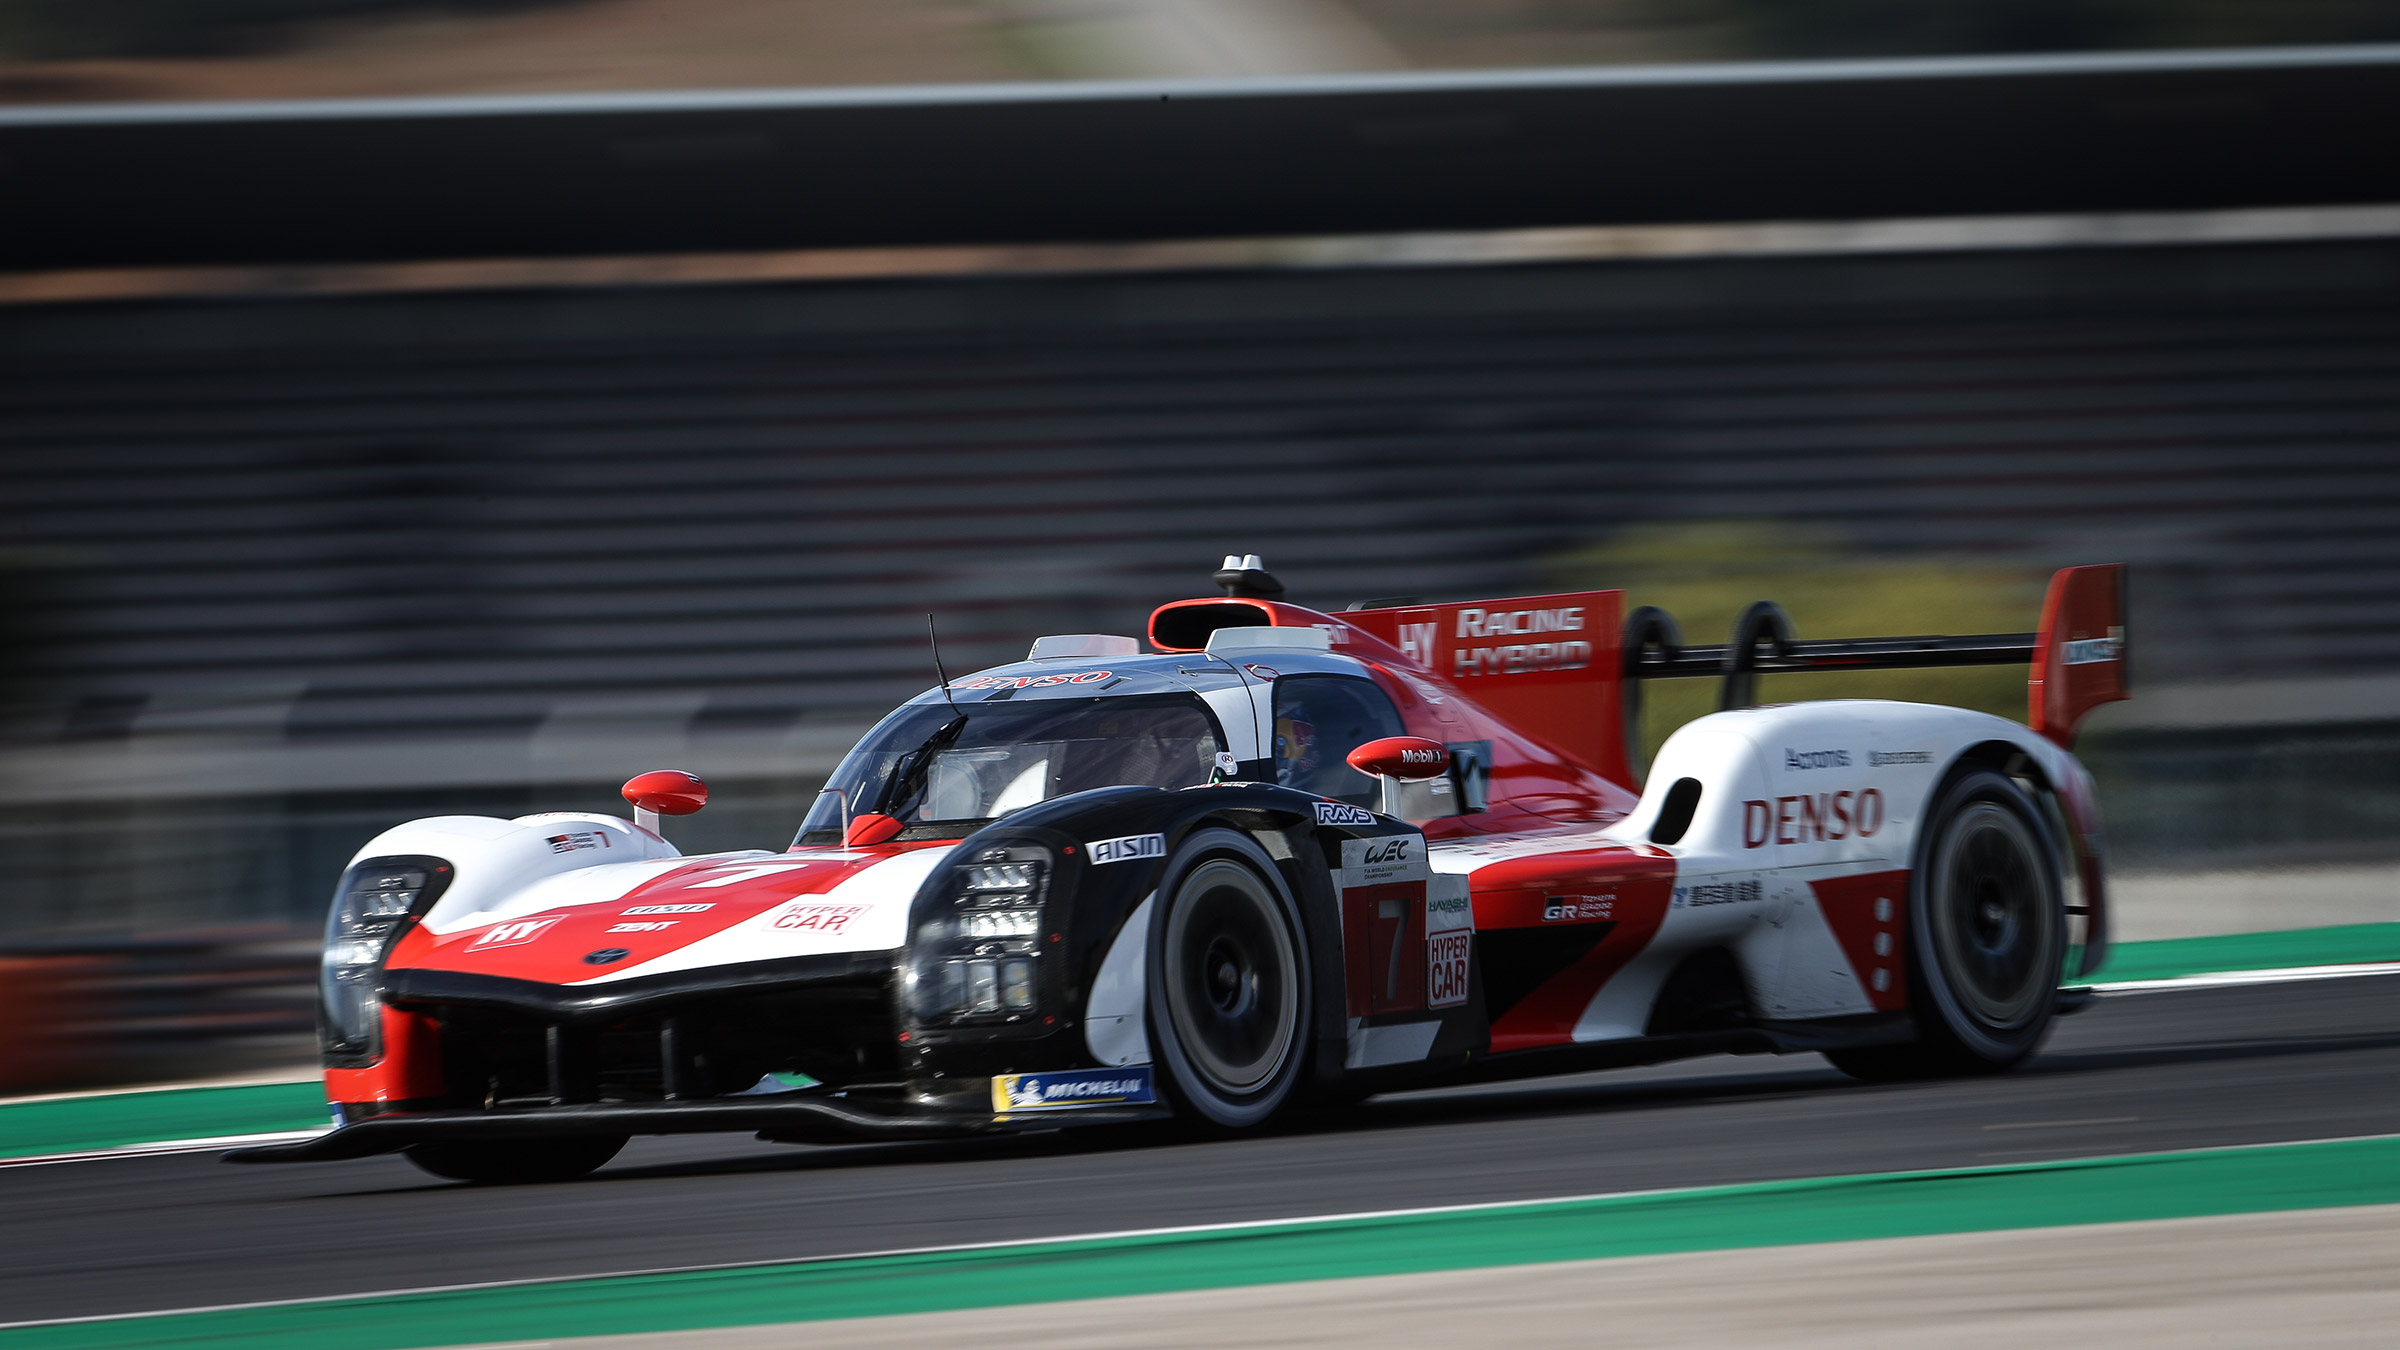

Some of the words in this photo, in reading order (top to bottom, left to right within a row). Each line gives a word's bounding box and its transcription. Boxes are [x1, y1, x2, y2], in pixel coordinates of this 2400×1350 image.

[1456, 607, 1586, 638] RACING
[1399, 622, 1438, 668] HY
[1453, 640, 1593, 677] HYBRID
[945, 671, 1113, 690] DENSO
[1402, 750, 1433, 763] Mobil
[1319, 805, 1371, 822] RAYS
[1742, 788, 1885, 849] DENSO
[593, 831, 611, 848] 7
[1096, 836, 1162, 862] AISIN
[1364, 840, 1409, 864] WEC
[787, 906, 862, 915] HYPER
[1428, 897, 1468, 912] HAYASHI
[1544, 905, 1578, 919] GR
[474, 919, 557, 945] HY
[604, 921, 681, 933] ZENT
[774, 914, 849, 931] CAR
[1378, 898, 1410, 1001] 7
[1432, 935, 1468, 962] HYPER
[1432, 959, 1466, 1000] CAR
[1044, 1078, 1142, 1099] MICHELIN
